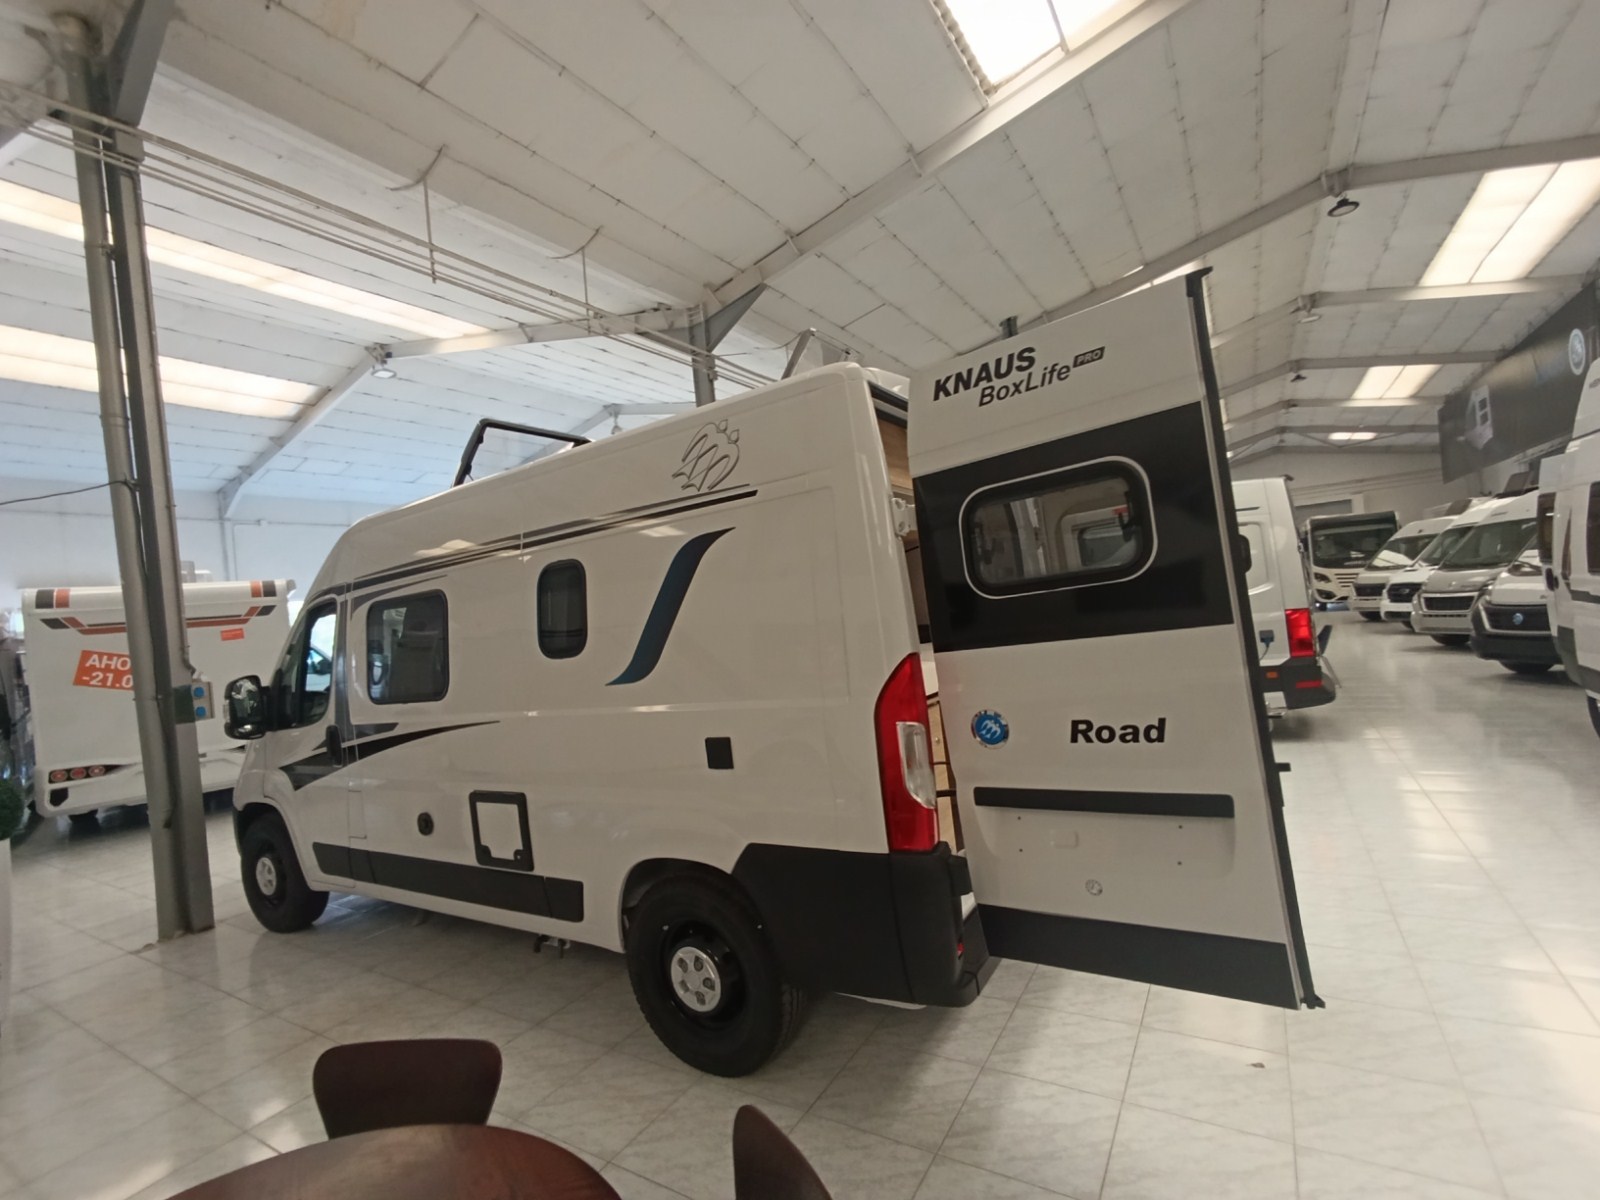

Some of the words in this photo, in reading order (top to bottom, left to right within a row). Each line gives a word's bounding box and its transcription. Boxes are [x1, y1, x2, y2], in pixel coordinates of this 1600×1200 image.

[933, 347, 1036, 401] KNAUS
[978, 363, 1071, 407] BoxLife
[1076, 351, 1101, 366] PRO
[85, 654, 131, 671] AHO
[82, 671, 133, 688] -21.0
[1070, 717, 1167, 744] Road
